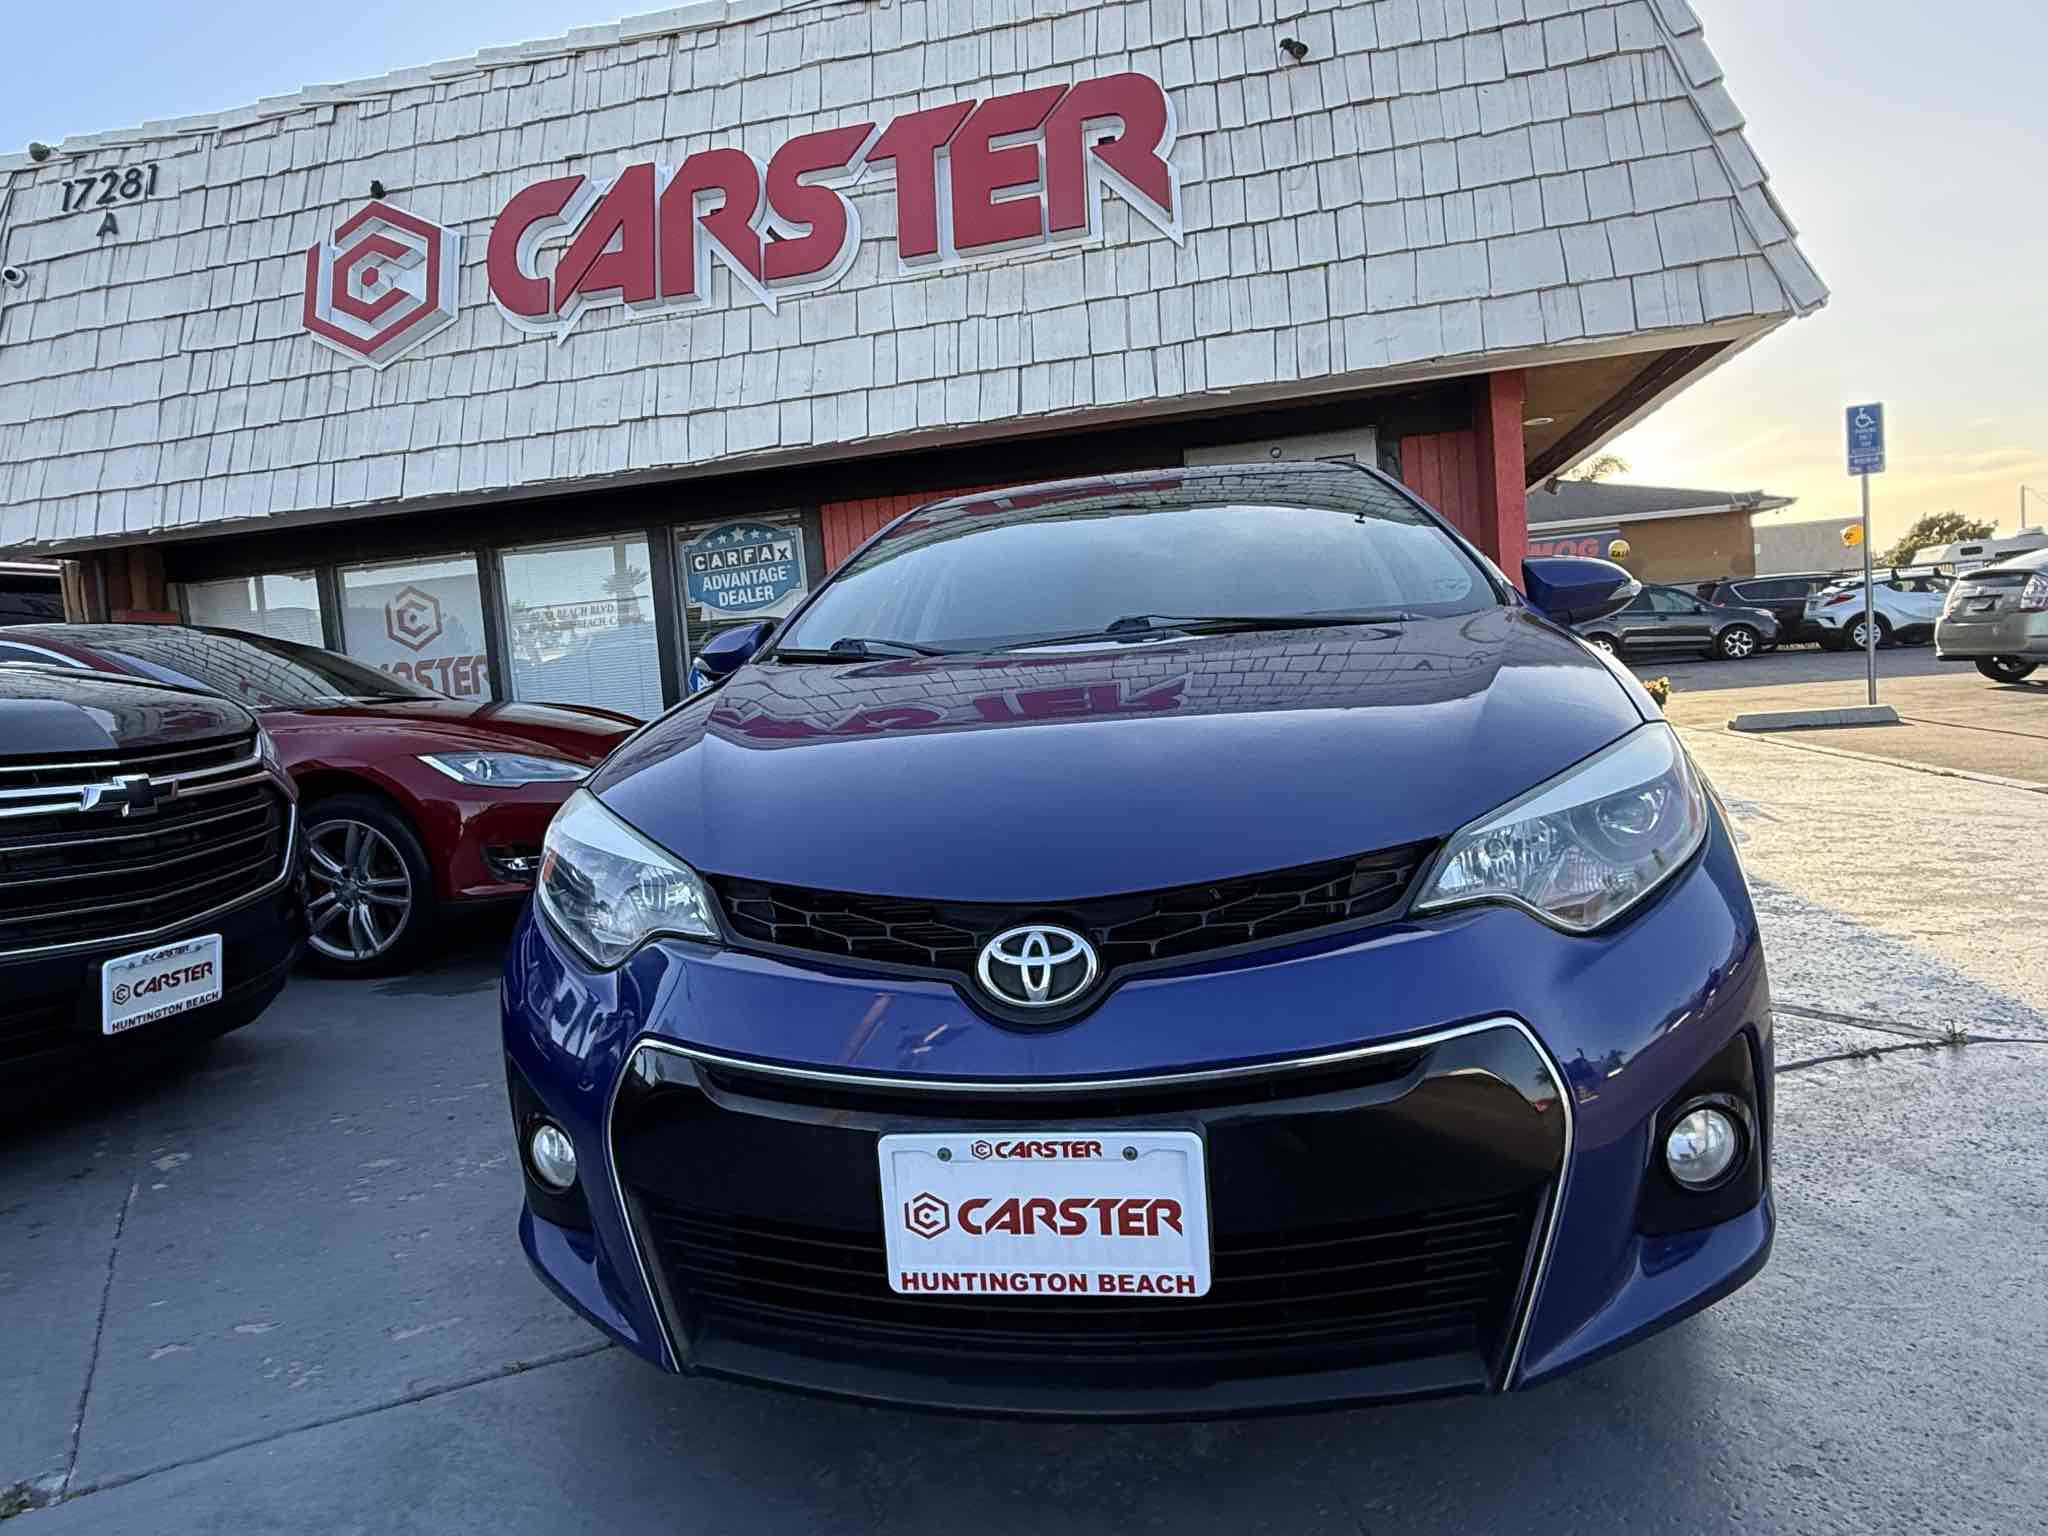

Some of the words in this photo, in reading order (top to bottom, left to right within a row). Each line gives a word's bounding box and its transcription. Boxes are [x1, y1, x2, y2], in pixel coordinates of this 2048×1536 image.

[62, 164, 159, 212] 17281
[487, 72, 1173, 317] CARSTER
[96, 212, 118, 237] A
[694, 547, 792, 570] CARFAX
[703, 565, 788, 592] ADVANTAGE
[719, 585, 775, 607] DEALER
[133, 961, 214, 997] CARSTER
[112, 1004, 183, 1032] HUNTINGTON
[186, 991, 220, 1010] BEACH
[995, 1141, 1102, 1158] CARSTER
[957, 1198, 1184, 1236] CARSTER
[900, 1272, 1089, 1292] HUNTINGTON
[1099, 1274, 1196, 1293] BEACH
